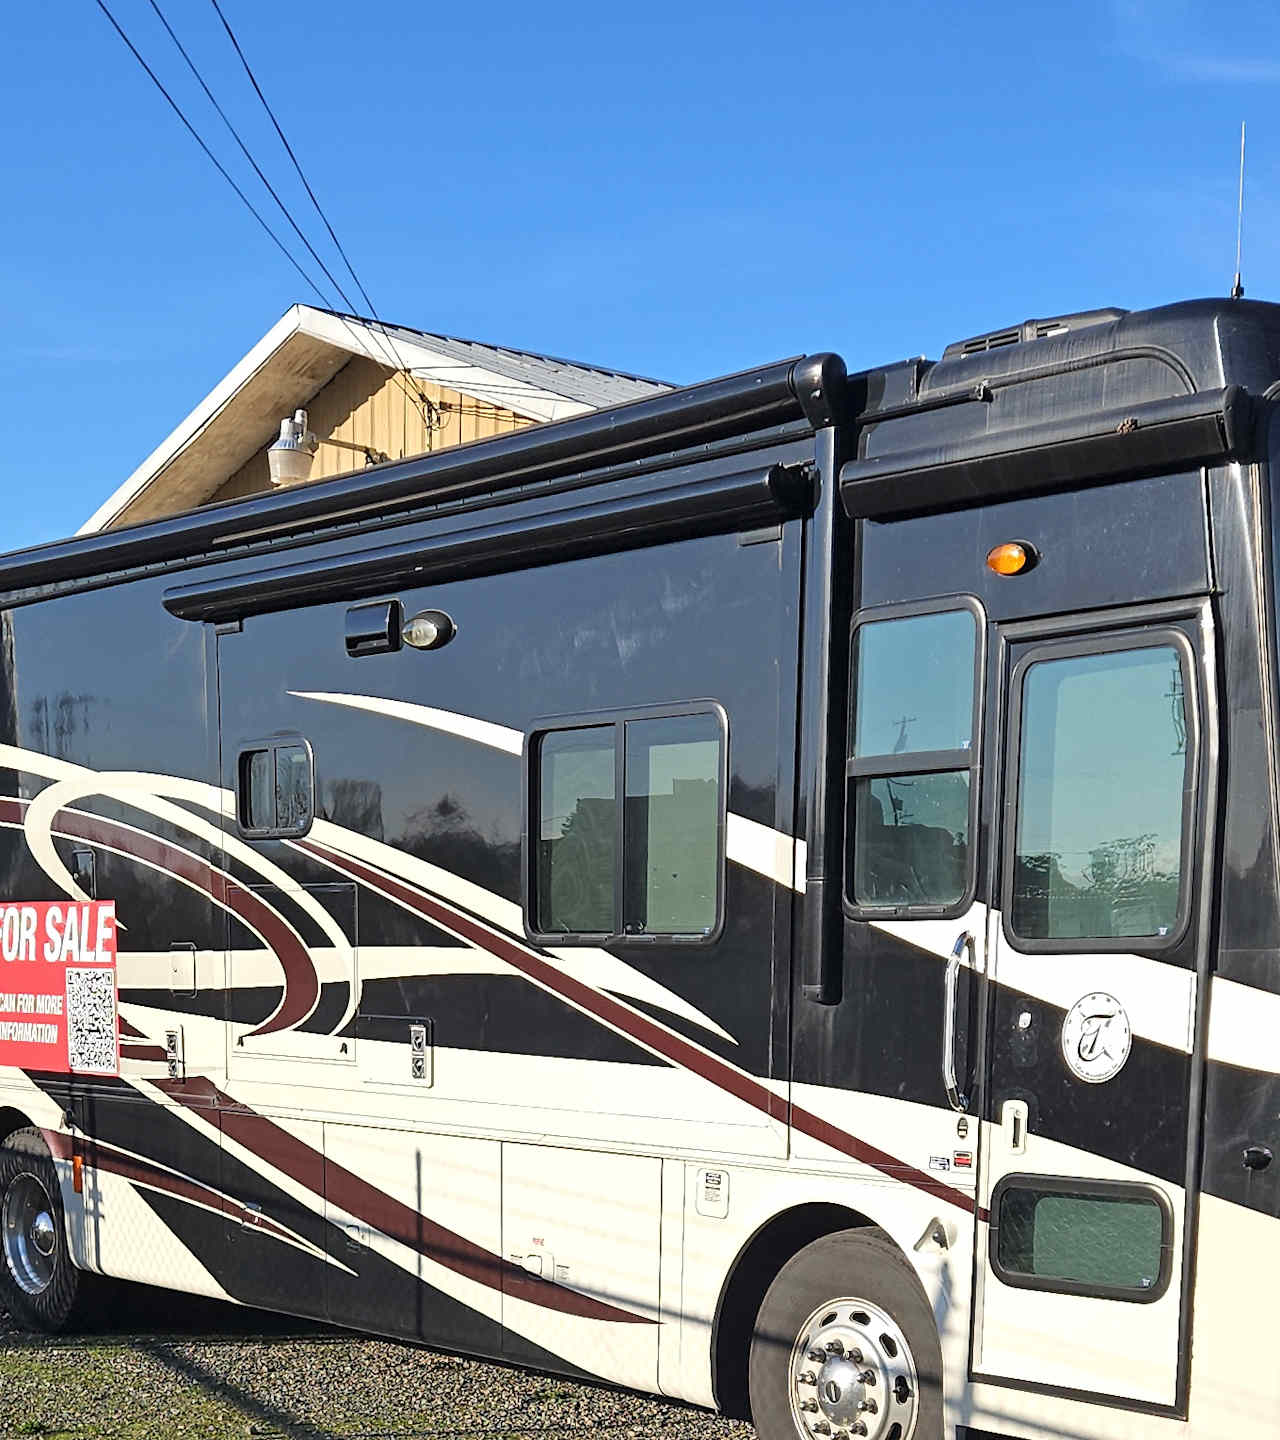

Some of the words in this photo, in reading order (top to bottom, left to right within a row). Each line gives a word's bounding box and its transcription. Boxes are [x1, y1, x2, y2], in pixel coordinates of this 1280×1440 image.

[43, 905, 115, 963] SALE
[16, 994, 35, 1014] FOR
[36, 995, 63, 1015] MORE
